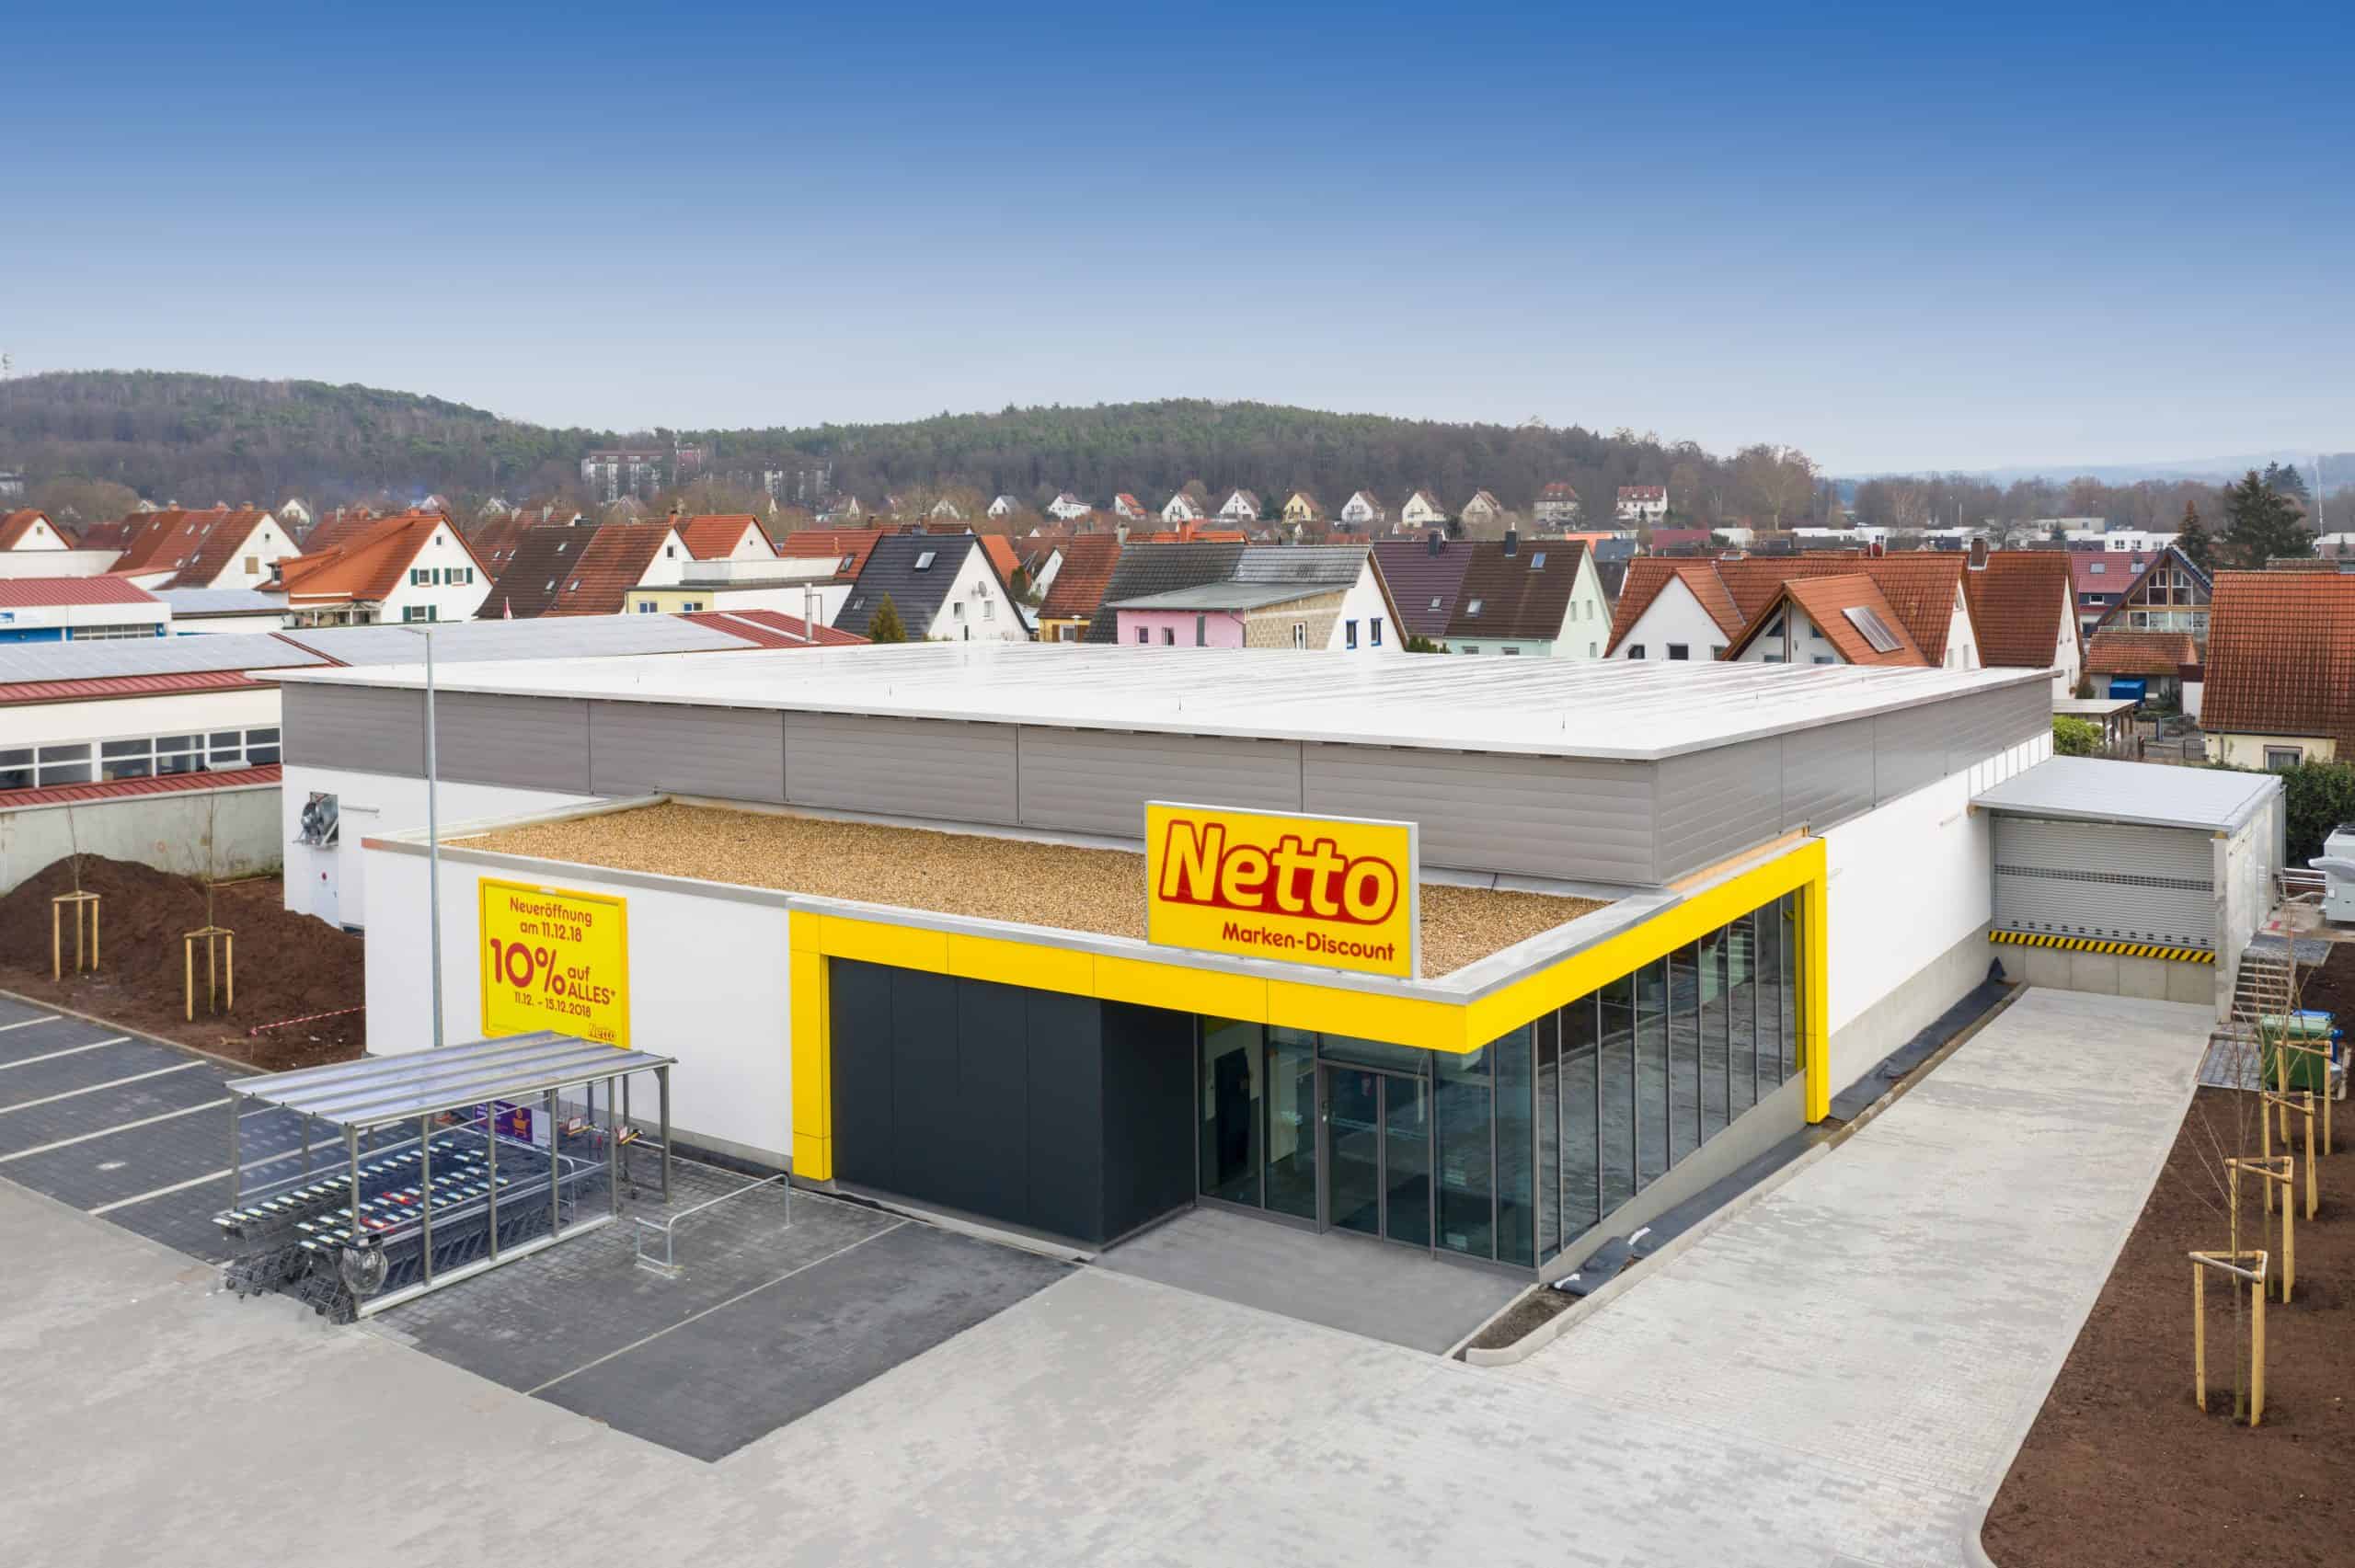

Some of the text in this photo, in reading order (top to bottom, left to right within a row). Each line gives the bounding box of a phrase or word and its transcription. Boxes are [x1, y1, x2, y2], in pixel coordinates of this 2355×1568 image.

[1158, 818, 1399, 926] Netto
[510, 897, 592, 927] Neueröffnung
[520, 921, 582, 943] am 11.12.18
[1223, 921, 1395, 961] Marken-Discount
[489, 938, 591, 996] 10% auf
[514, 991, 534, 1006] 11.12.
[545, 997, 592, 1018] 15.12.2018
